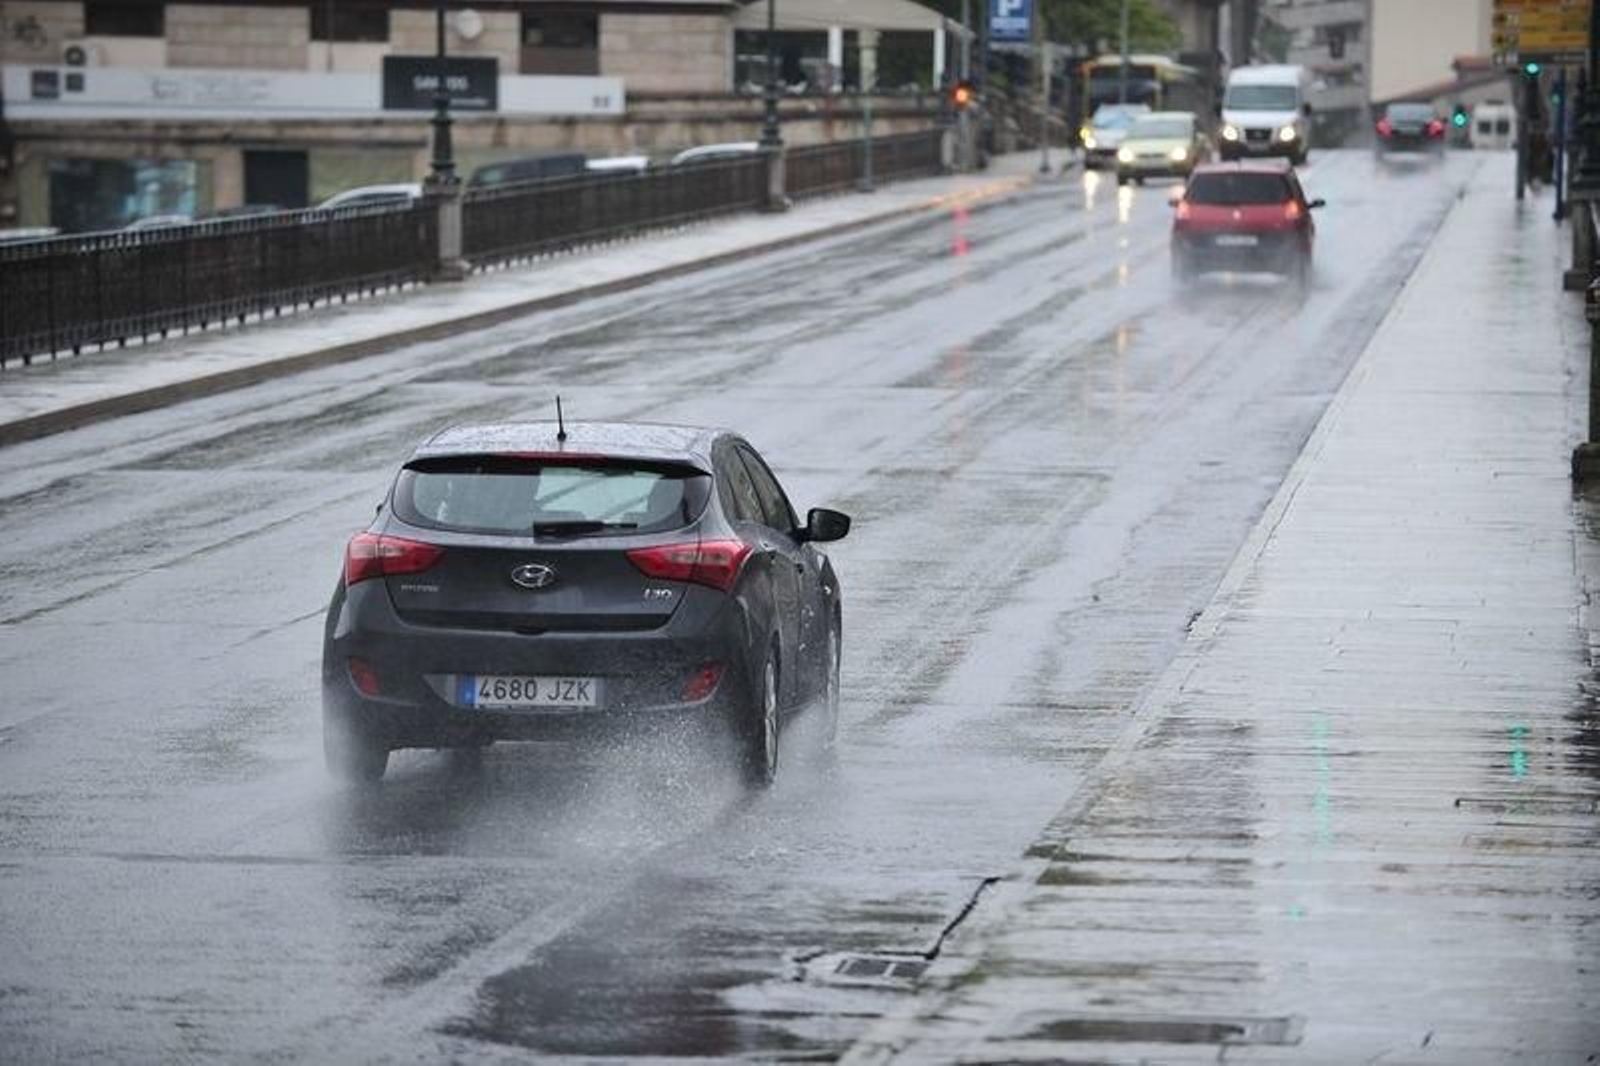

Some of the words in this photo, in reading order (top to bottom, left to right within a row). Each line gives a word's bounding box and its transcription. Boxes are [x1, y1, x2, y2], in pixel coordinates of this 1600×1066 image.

[998, 0, 1022, 16] P
[479, 679, 538, 700] 4680
[547, 680, 591, 701] JZK
